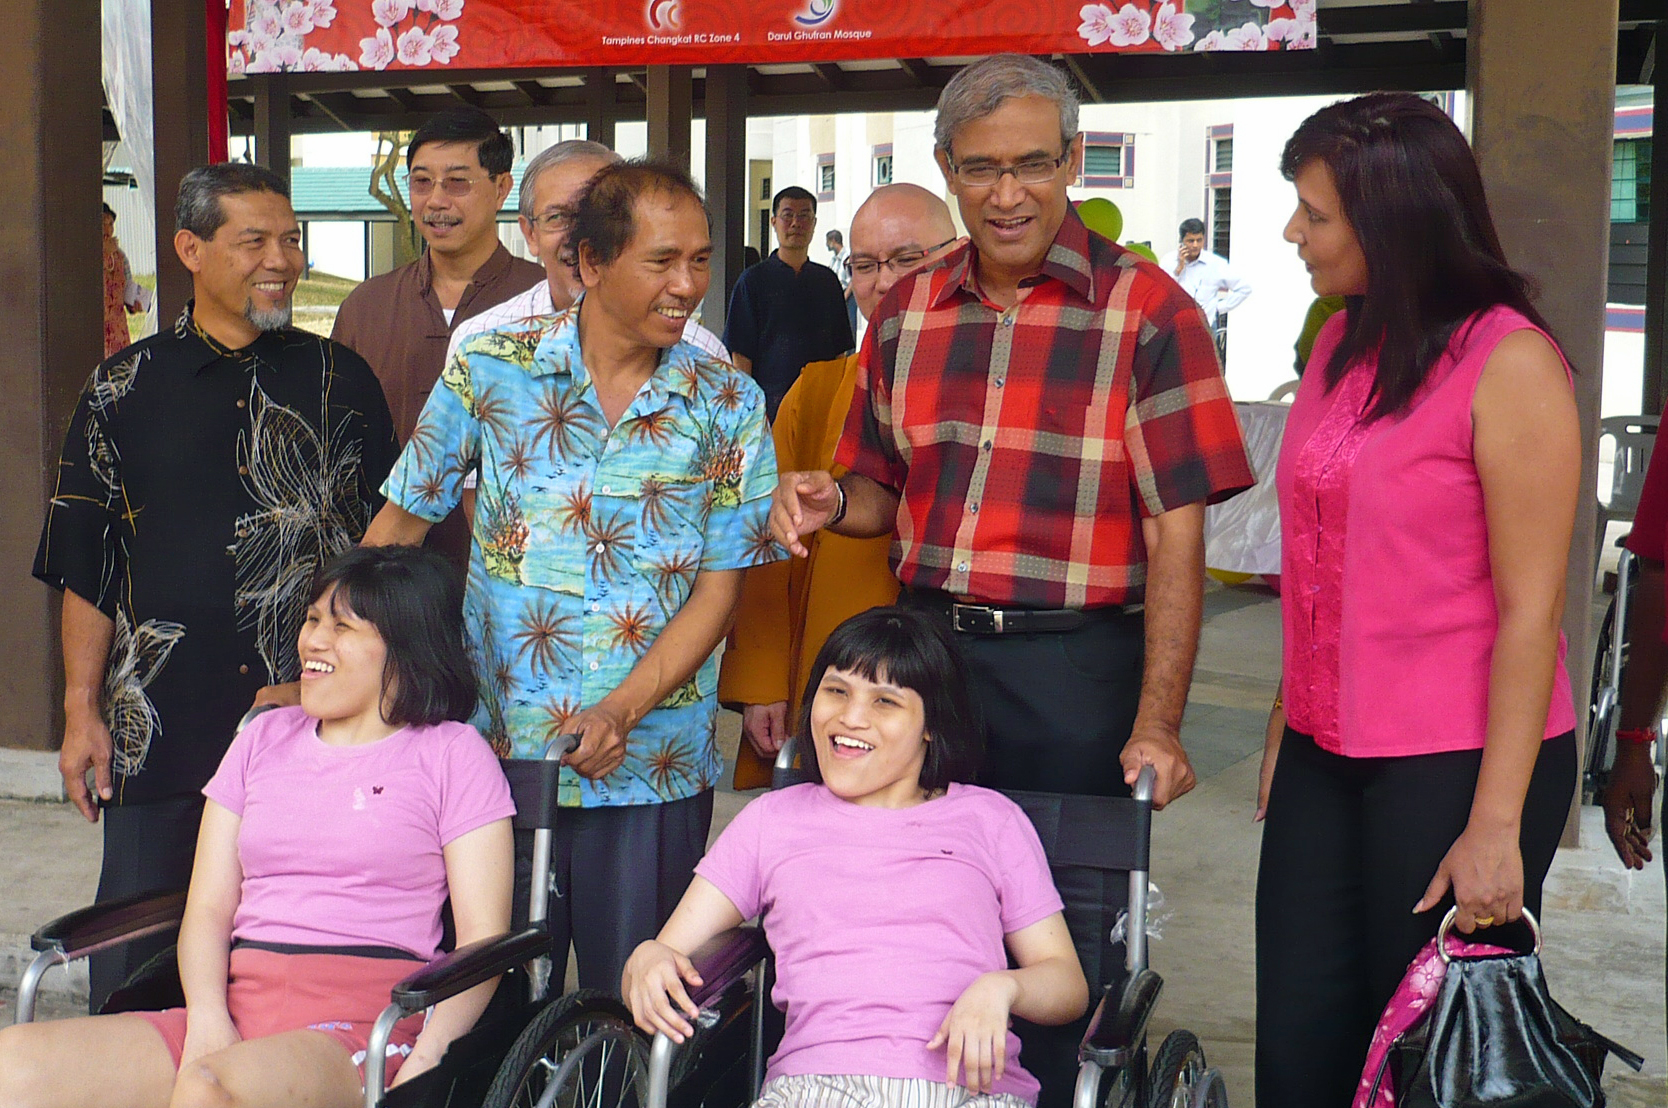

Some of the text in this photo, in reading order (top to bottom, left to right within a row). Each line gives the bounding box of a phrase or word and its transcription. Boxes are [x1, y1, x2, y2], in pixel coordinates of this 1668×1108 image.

[602, 32, 740, 47] Tampines Changkat RC Zone 4
[767, 29, 872, 41] Darul Ghufran Mosque
